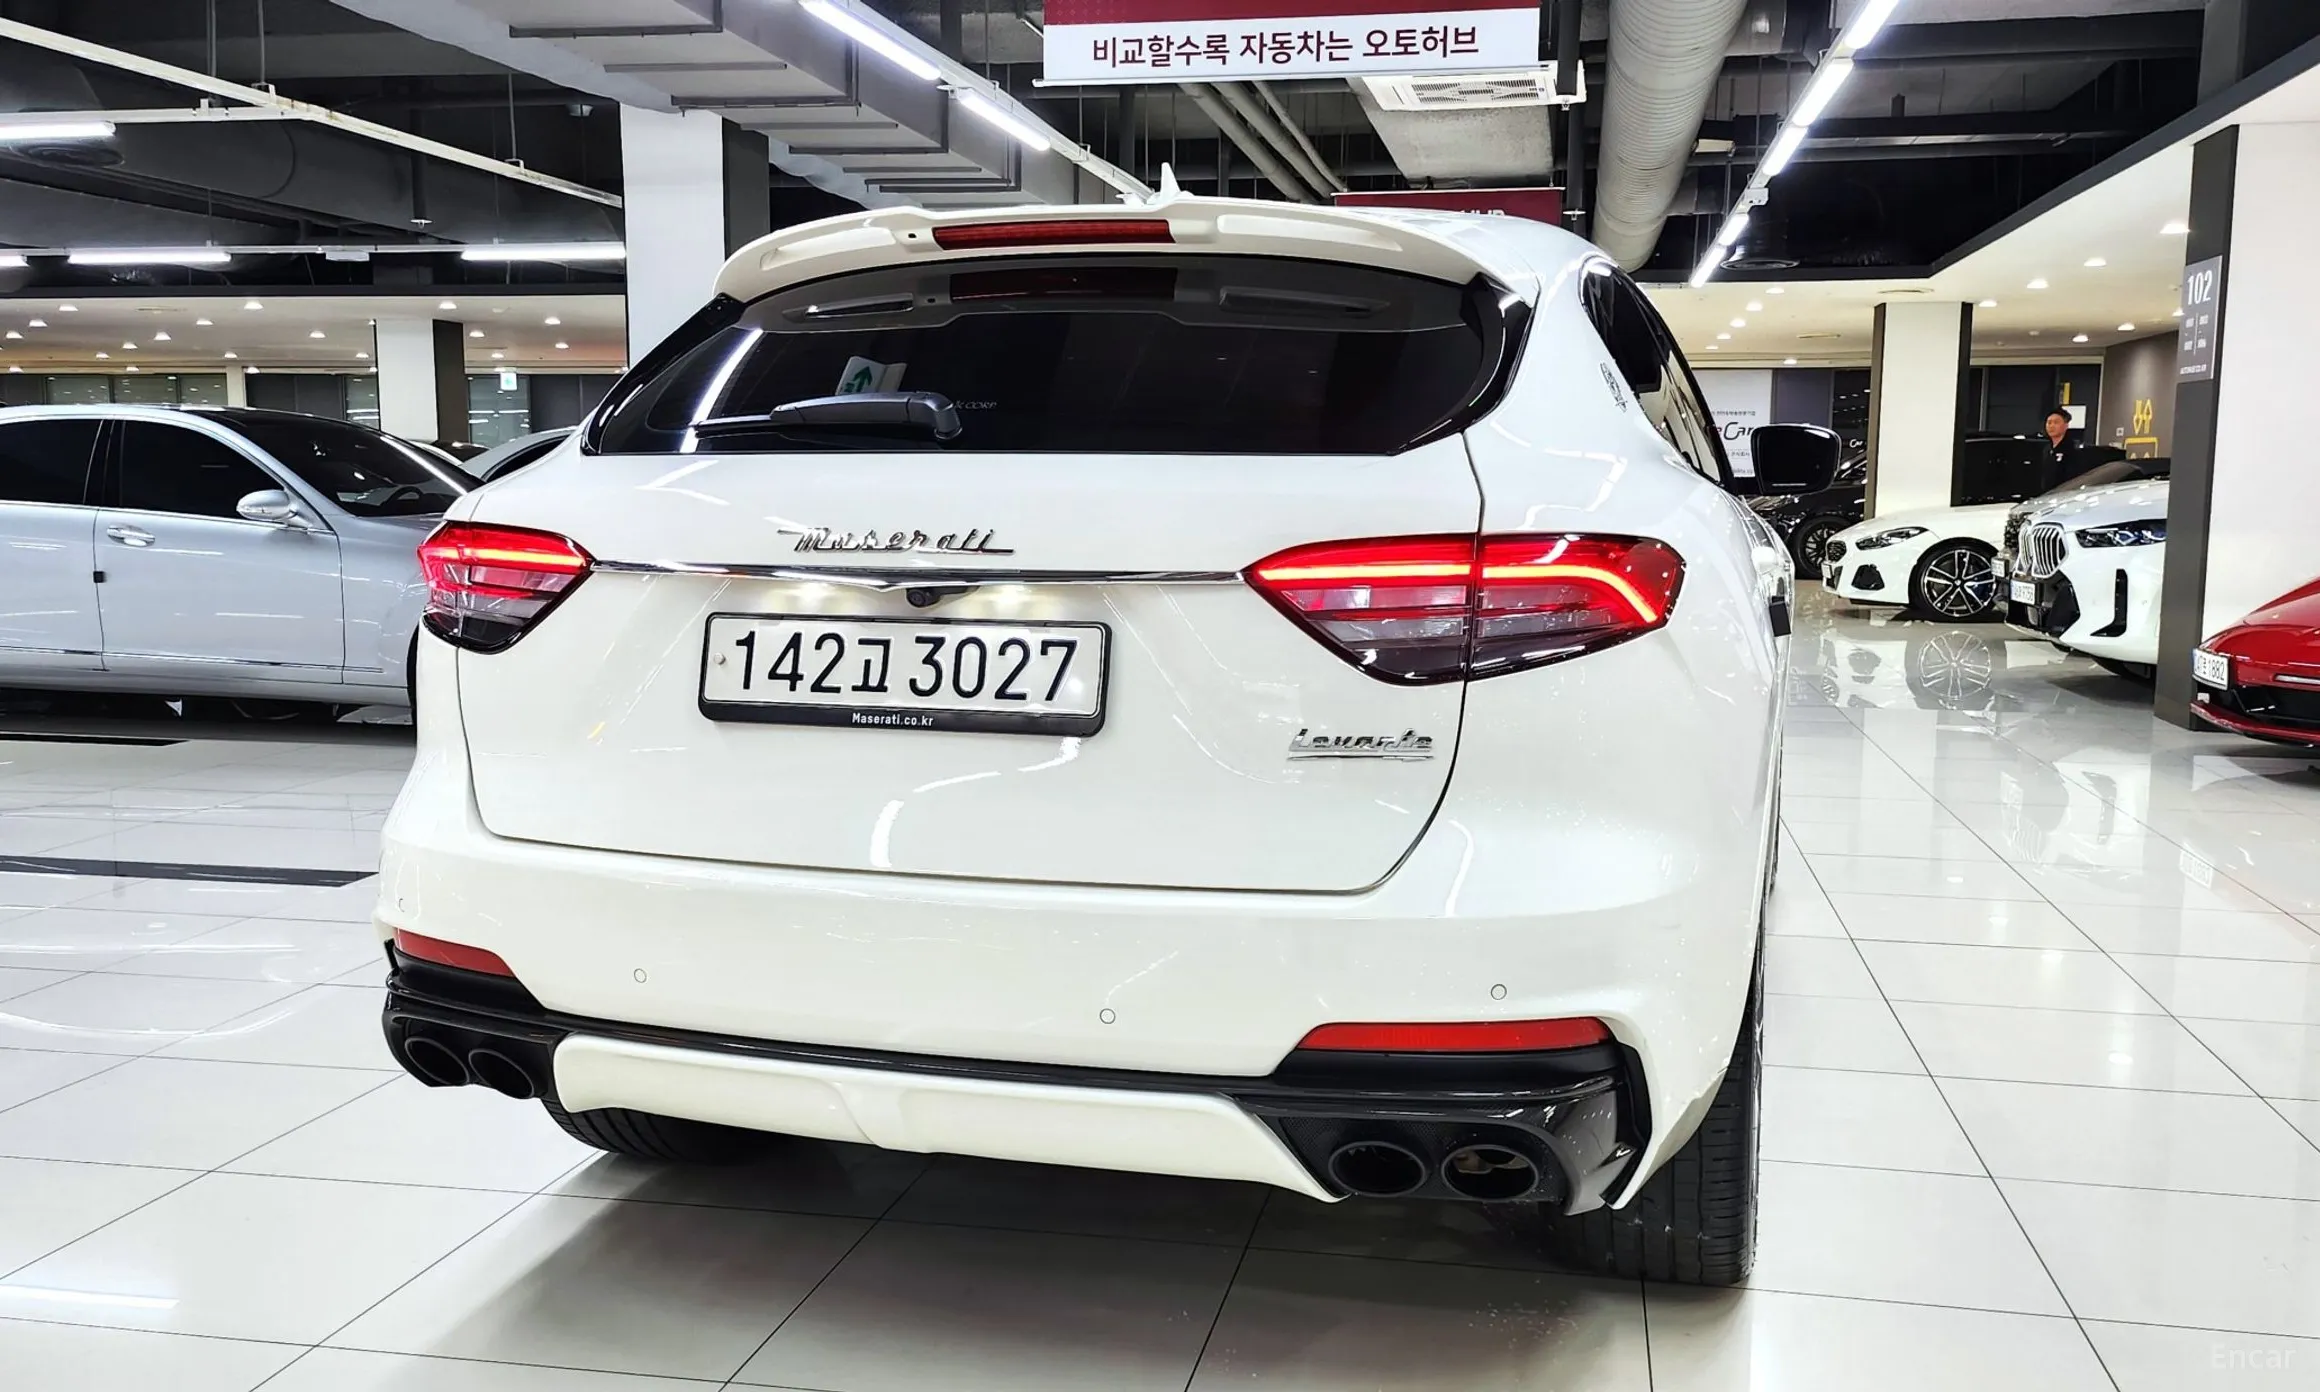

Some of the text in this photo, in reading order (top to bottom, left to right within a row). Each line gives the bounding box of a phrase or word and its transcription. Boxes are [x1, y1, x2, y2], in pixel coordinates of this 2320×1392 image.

[1093, 25, 1480, 68] 비교할수록 자동차는 오토허브
[2187, 270, 2213, 305] 102
[777, 527, 1015, 555] Maserati
[734, 630, 1078, 702] 142고 3027
[851, 712, 934, 727] Maserati.co.kr
[1287, 728, 1434, 755] Levante
